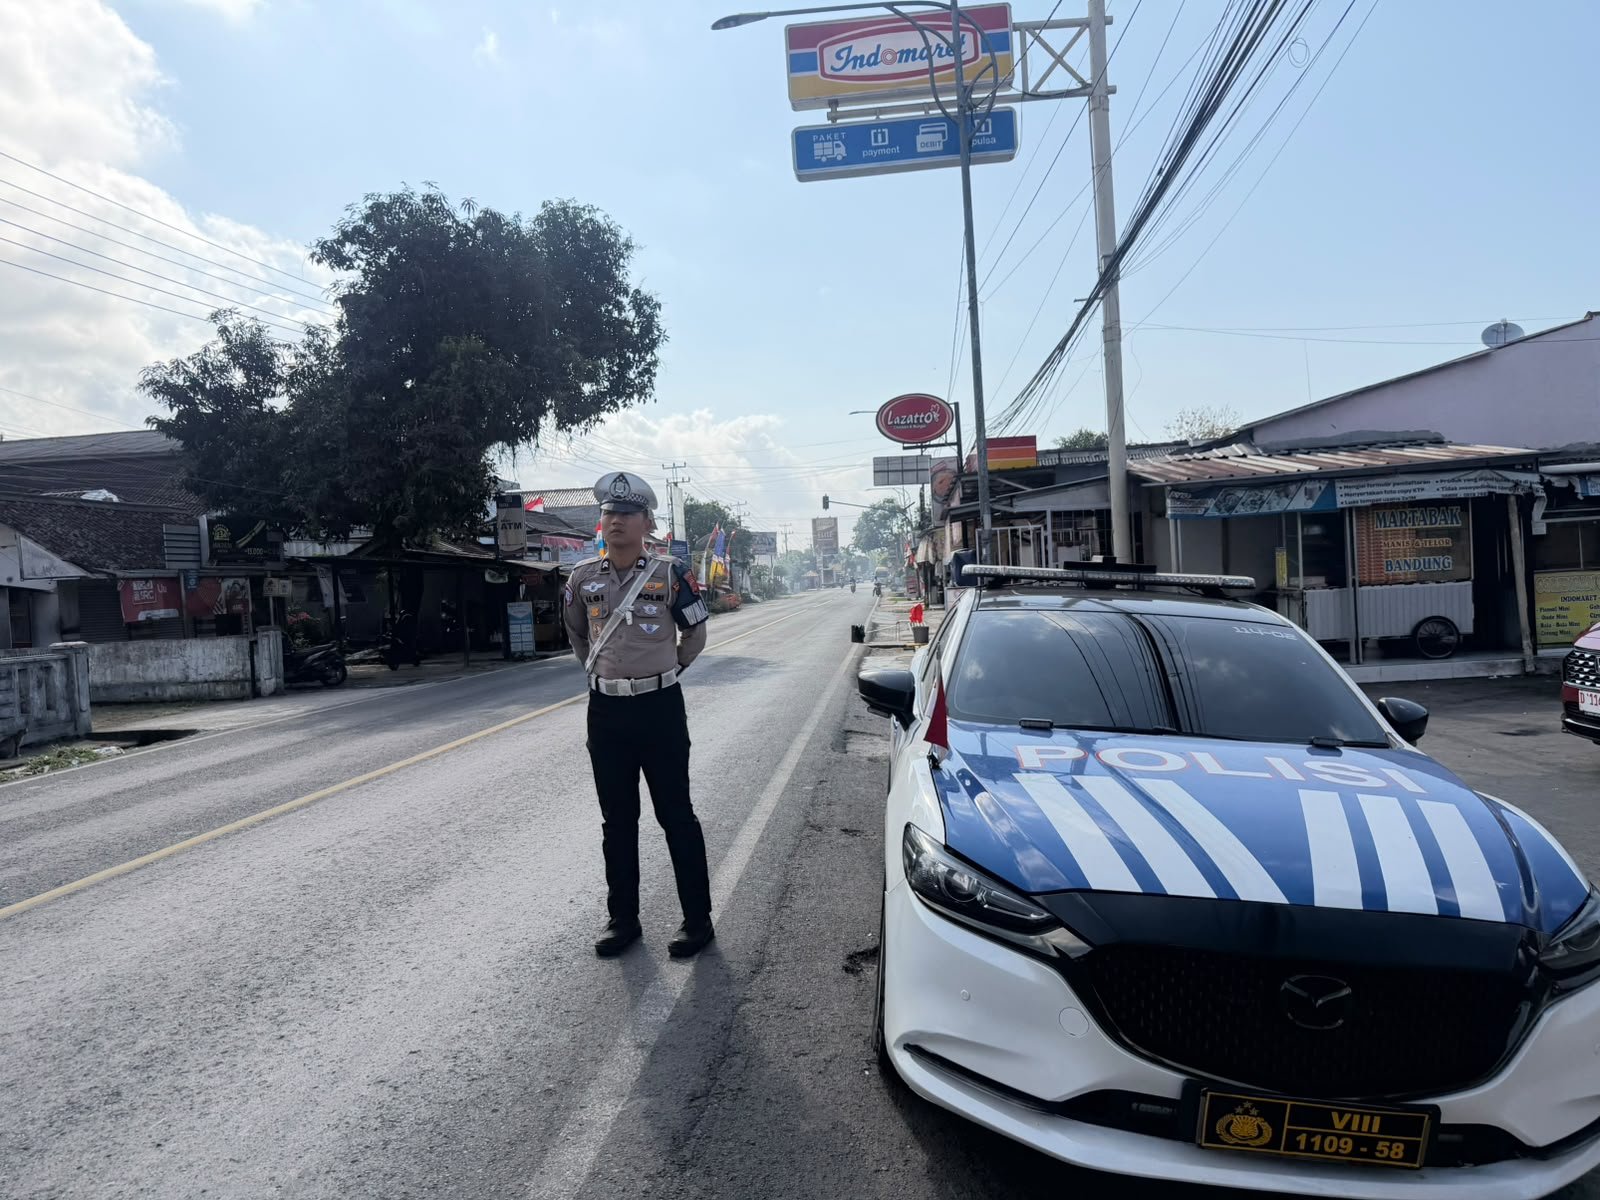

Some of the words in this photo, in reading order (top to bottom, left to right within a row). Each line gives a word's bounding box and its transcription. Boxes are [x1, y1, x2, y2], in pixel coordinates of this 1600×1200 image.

[830, 34, 967, 73] Indomaret
[812, 132, 847, 142] PAKET
[971, 136, 997, 148] pulsa
[862, 145, 900, 158] payment
[920, 140, 943, 149] DEBIT
[887, 410, 933, 425] Lazatto
[1375, 506, 1462, 529] MARTABAK
[500, 522, 522, 530] ATM
[1383, 539, 1410, 548] MANIS
[1424, 538, 1452, 547] TELOR
[1385, 555, 1453, 572] BANDUNG
[636, 593, 665, 602] POLRI
[1013, 744, 1428, 794] POLISI
[1331, 1111, 1381, 1133] VIII
[1296, 1132, 1353, 1154] 1109
[1375, 1141, 1405, 1159] 58
